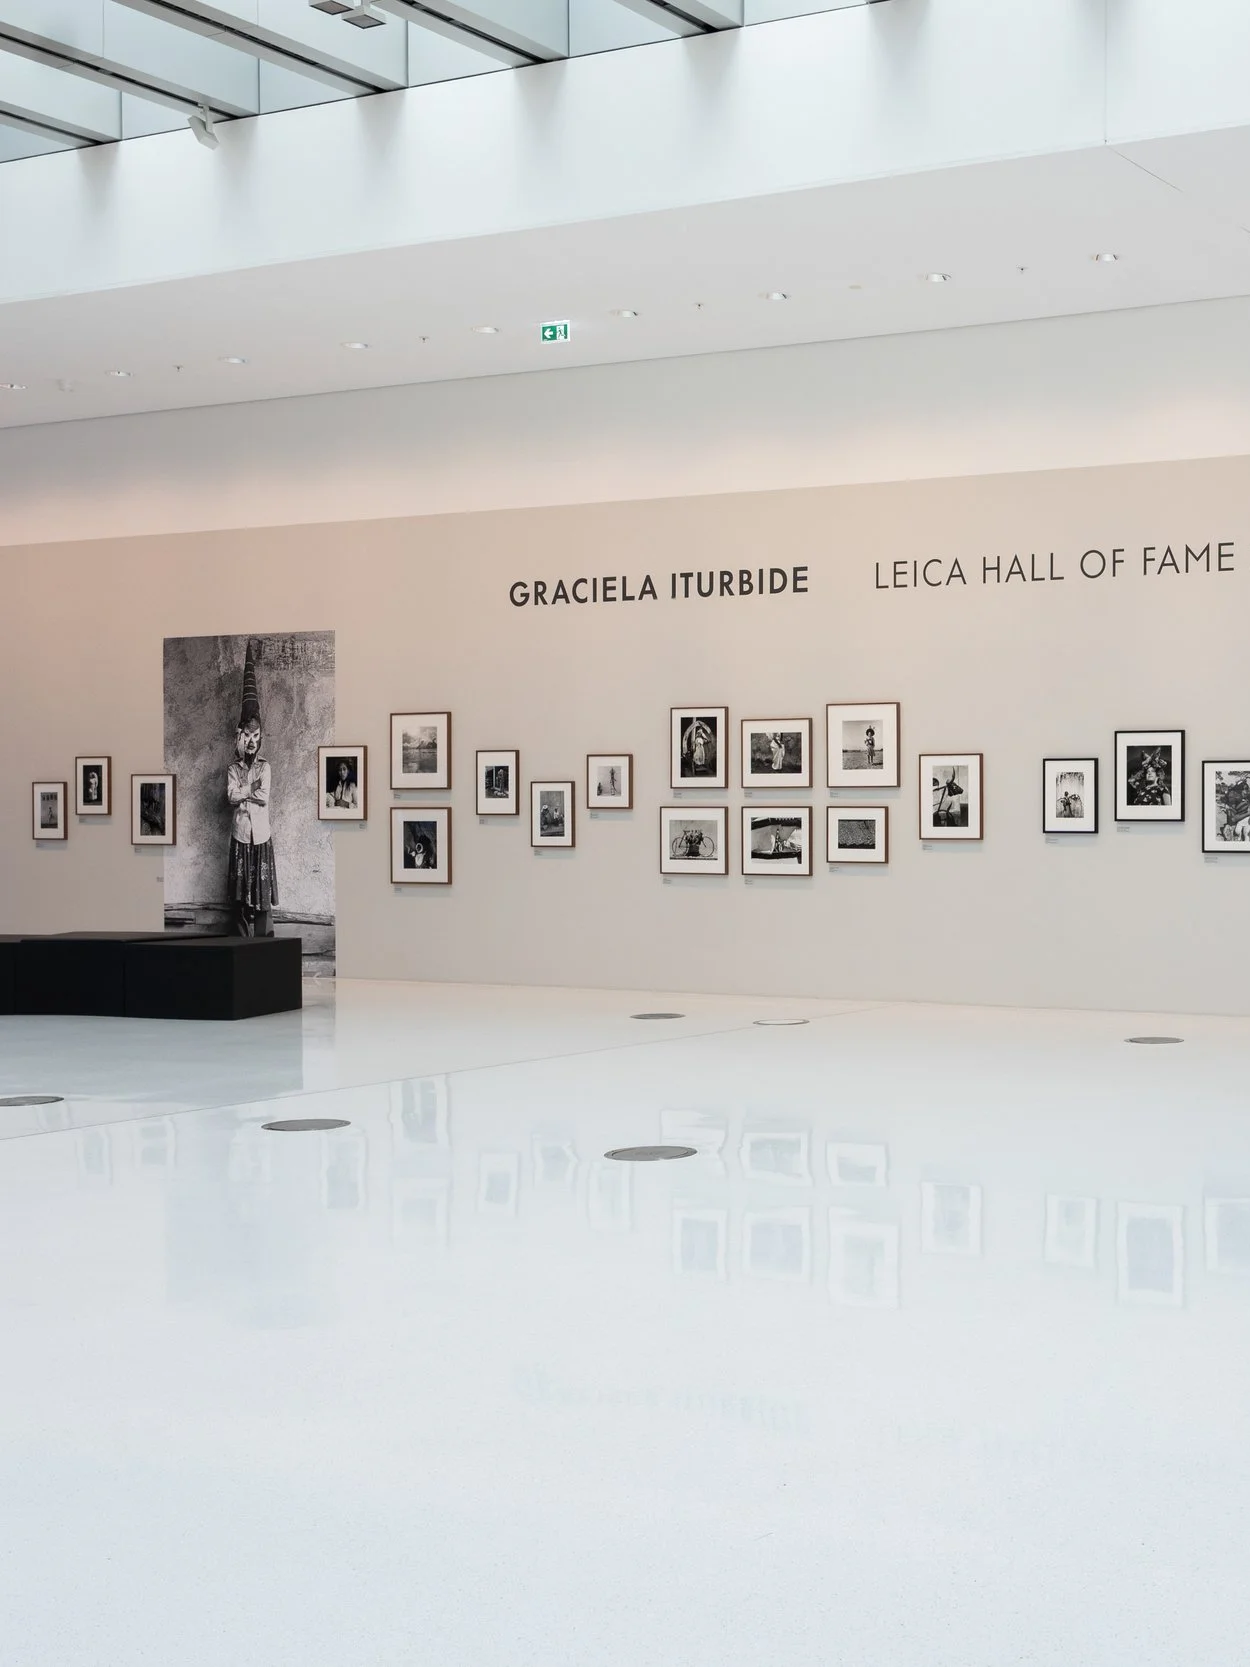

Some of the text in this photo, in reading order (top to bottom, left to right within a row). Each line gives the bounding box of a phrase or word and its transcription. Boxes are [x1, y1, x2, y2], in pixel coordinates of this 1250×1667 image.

[509, 574, 659, 608] GRACIELA
[670, 565, 809, 600] ITURBIDE
[874, 556, 968, 590] LEICA
[982, 552, 1065, 585] HALL
[1079, 548, 1125, 580] OF
[1142, 541, 1236, 576] FAME
